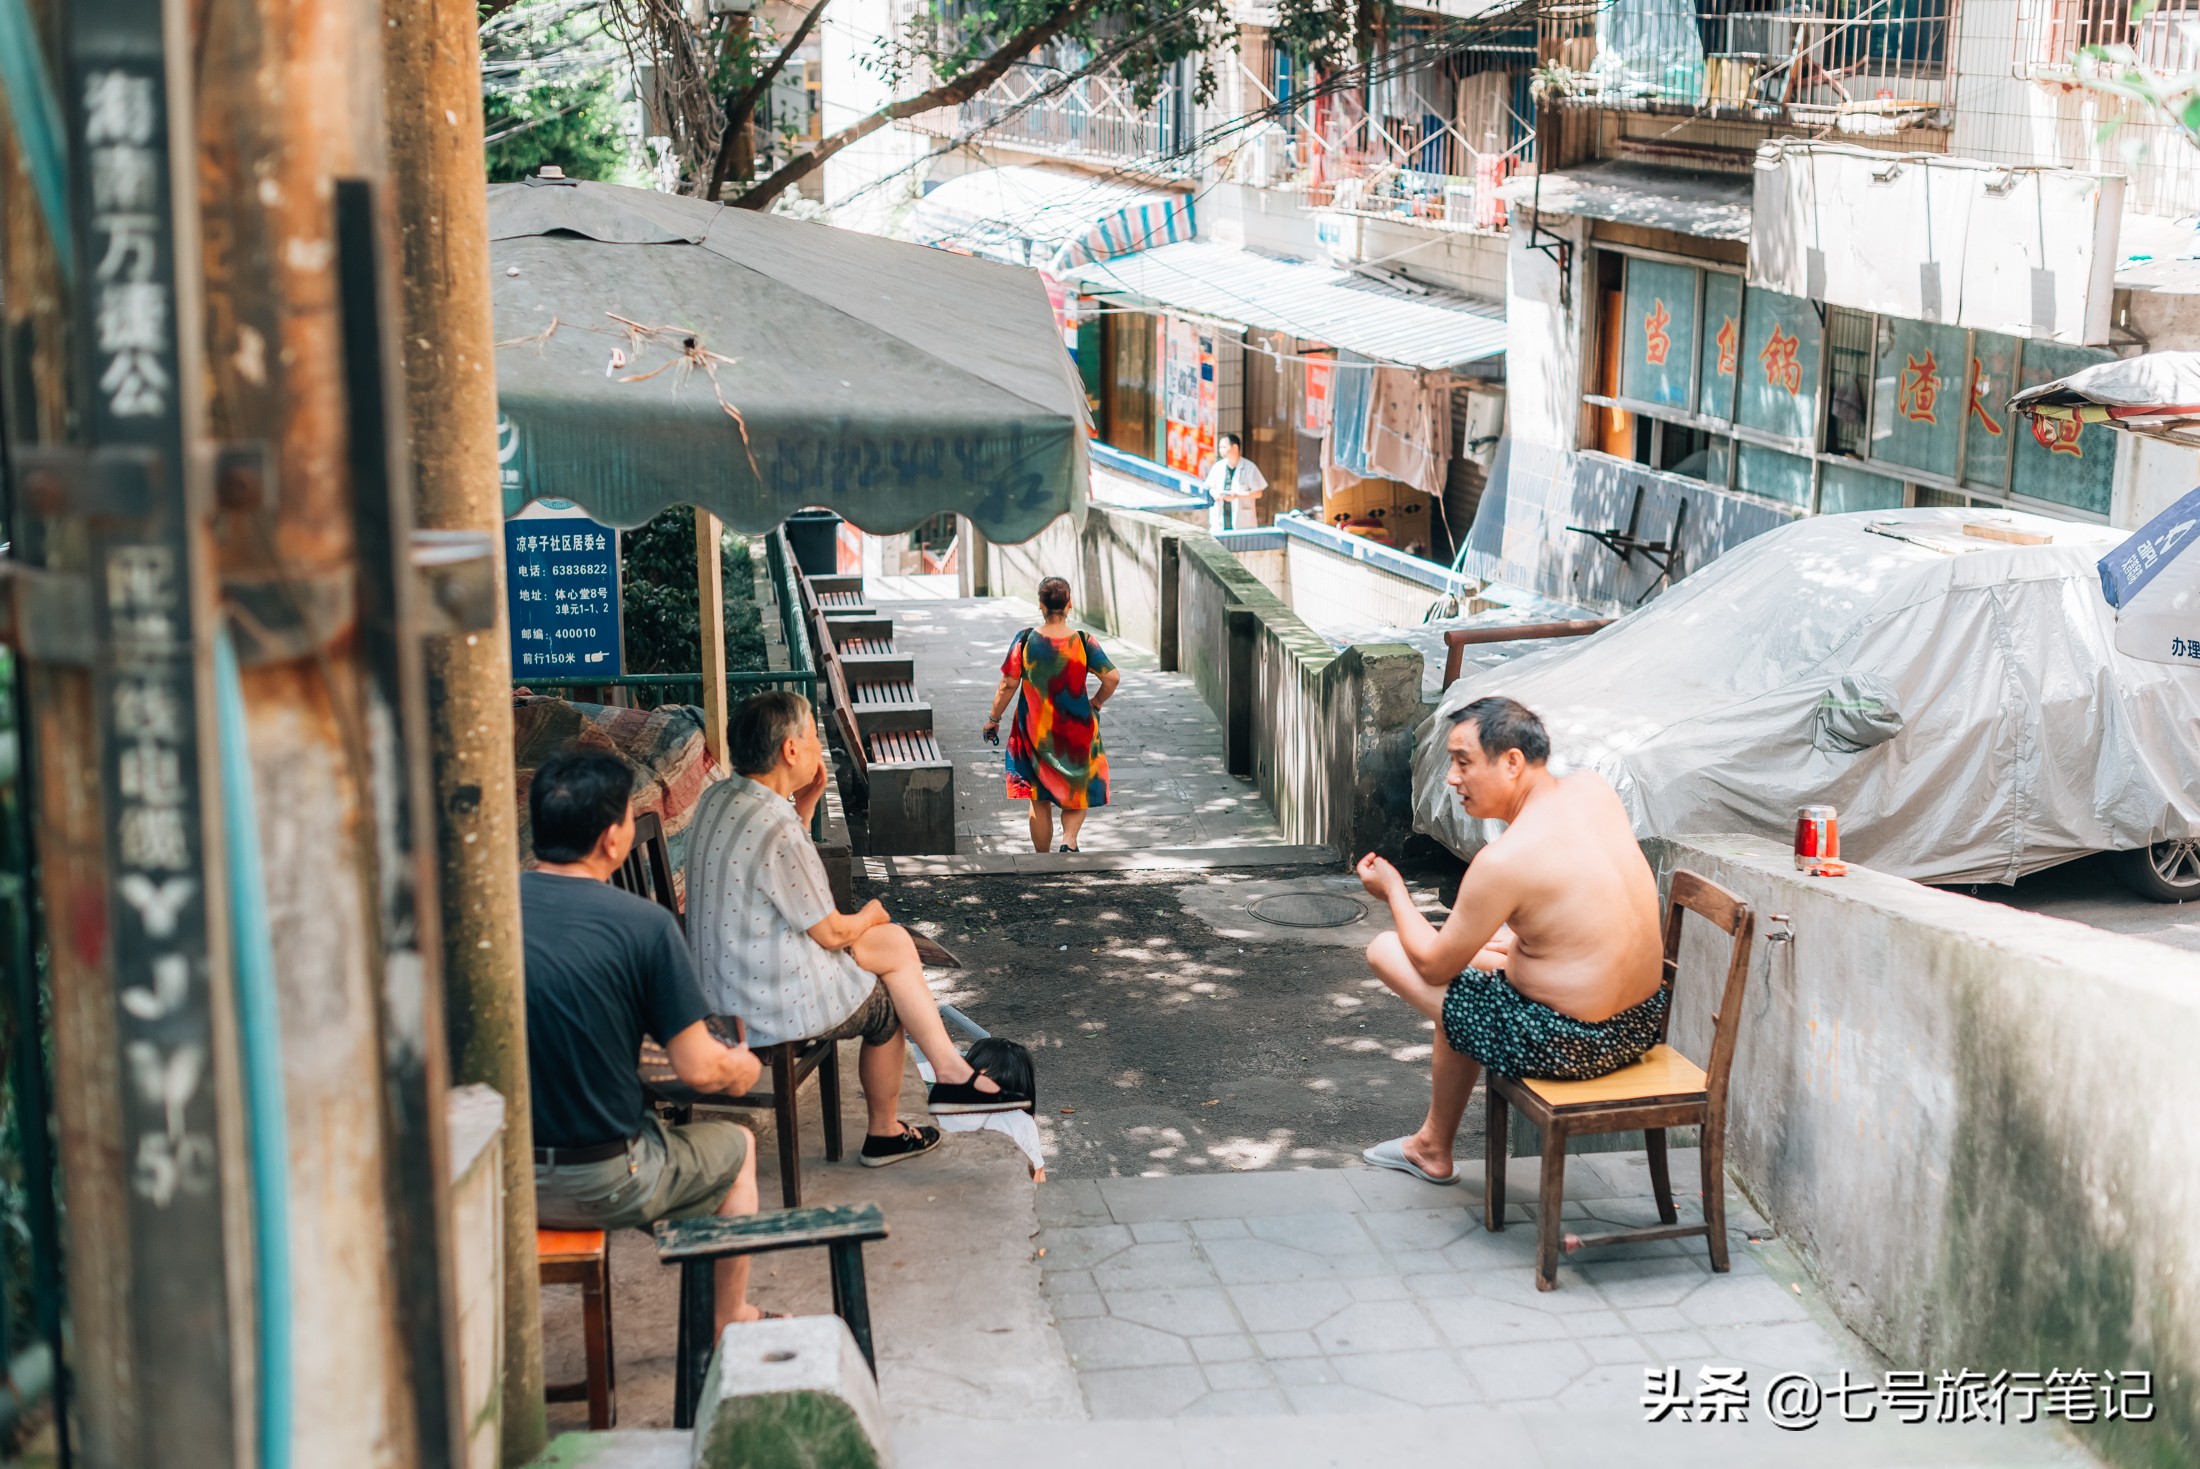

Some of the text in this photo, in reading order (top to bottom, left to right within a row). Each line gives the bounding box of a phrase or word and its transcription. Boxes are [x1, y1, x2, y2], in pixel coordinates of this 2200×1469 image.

[516, 533, 606, 553] 凉亭子社区居委会
[552, 564, 608, 576] 63836822
[554, 587, 608, 600] 体心堂8号
[555, 627, 596, 639] 400010
[2171, 636, 2200, 660] 办理
[522, 652, 576, 664] 前行150米
